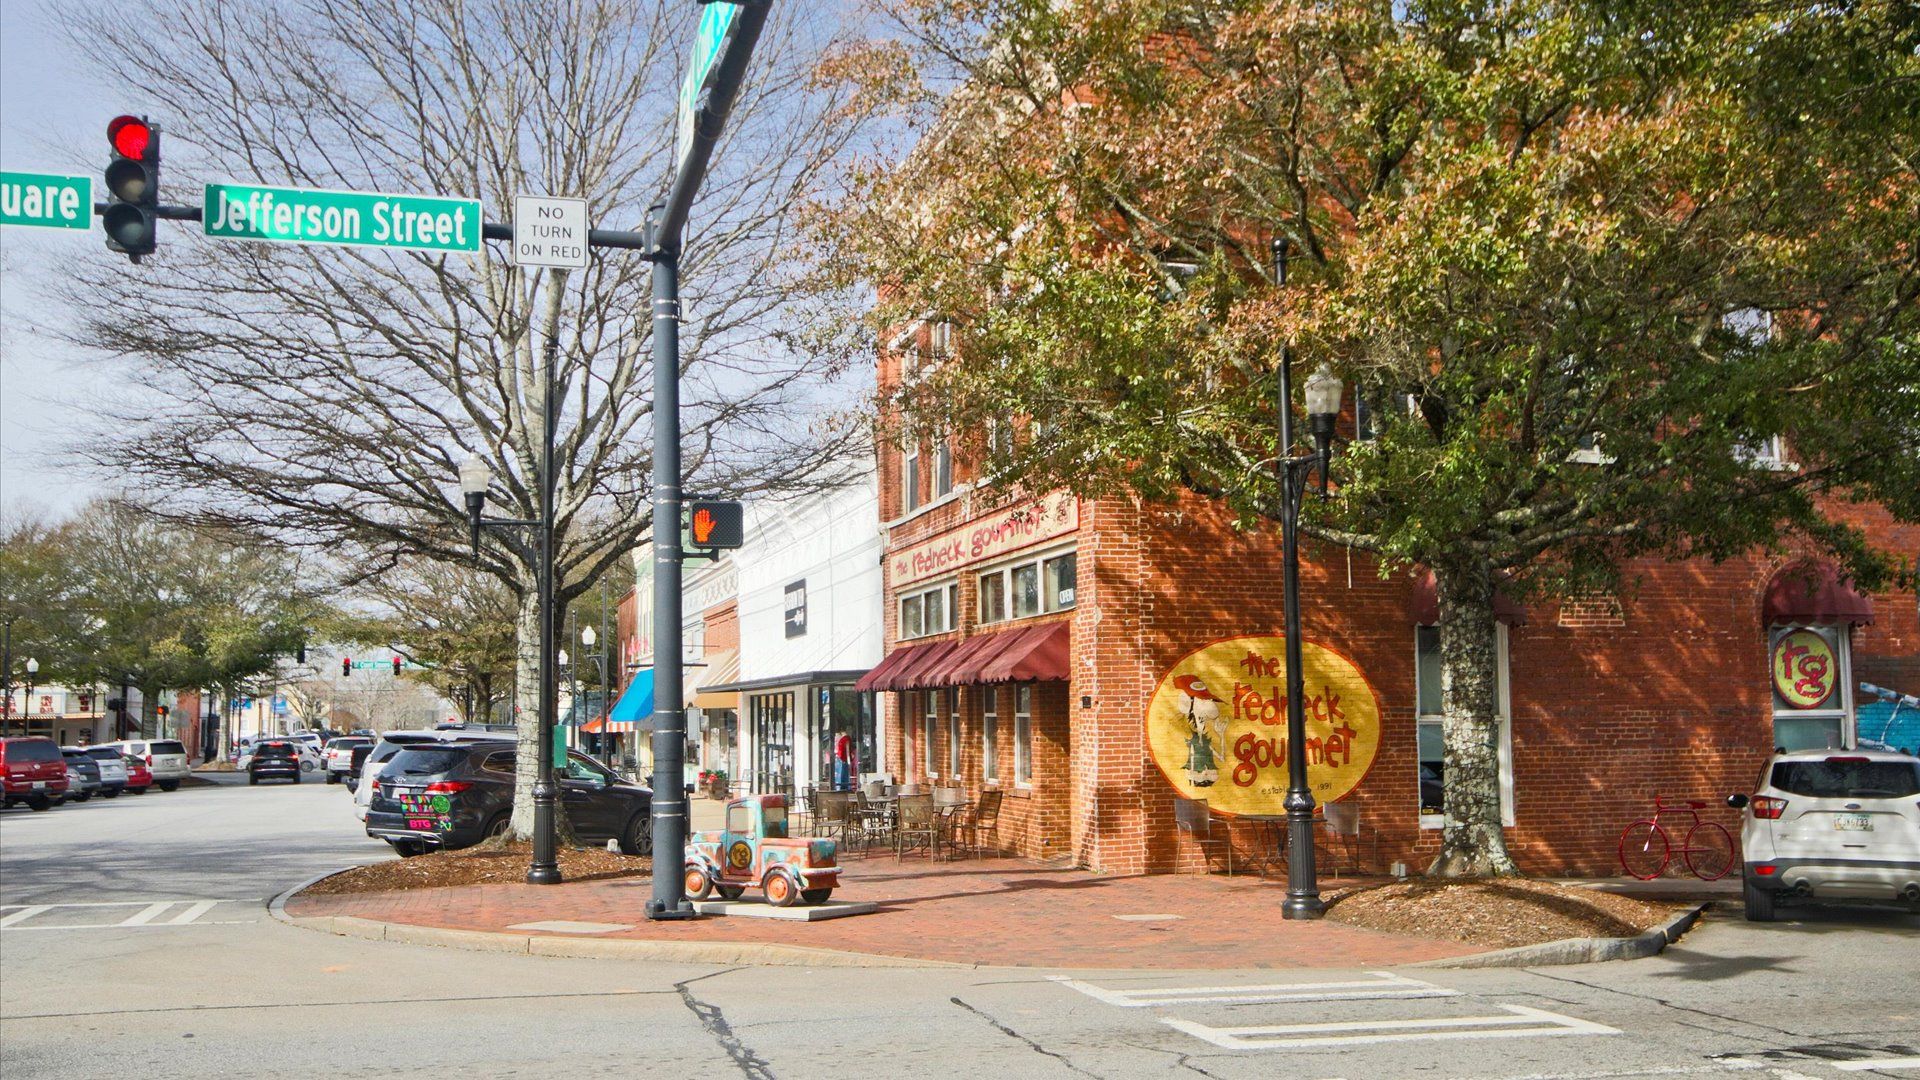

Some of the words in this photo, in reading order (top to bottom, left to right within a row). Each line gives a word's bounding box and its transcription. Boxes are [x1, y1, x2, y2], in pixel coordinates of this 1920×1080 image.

[212, 190, 361, 240] Jefferson
[372, 201, 467, 246] Street
[538, 206, 564, 219] NO
[531, 224, 572, 239] TURN
[521, 243, 542, 256] ON
[551, 245, 581, 259] RED
[895, 558, 908, 577] the
[911, 539, 966, 576] redneck
[970, 504, 1045, 558] gourmet
[1240, 651, 1281, 678] the
[1782, 639, 1829, 699] rg
[1232, 721, 1358, 787] goumet
[1317, 782, 1332, 791] 1991
[409, 819, 432, 829] BTG
